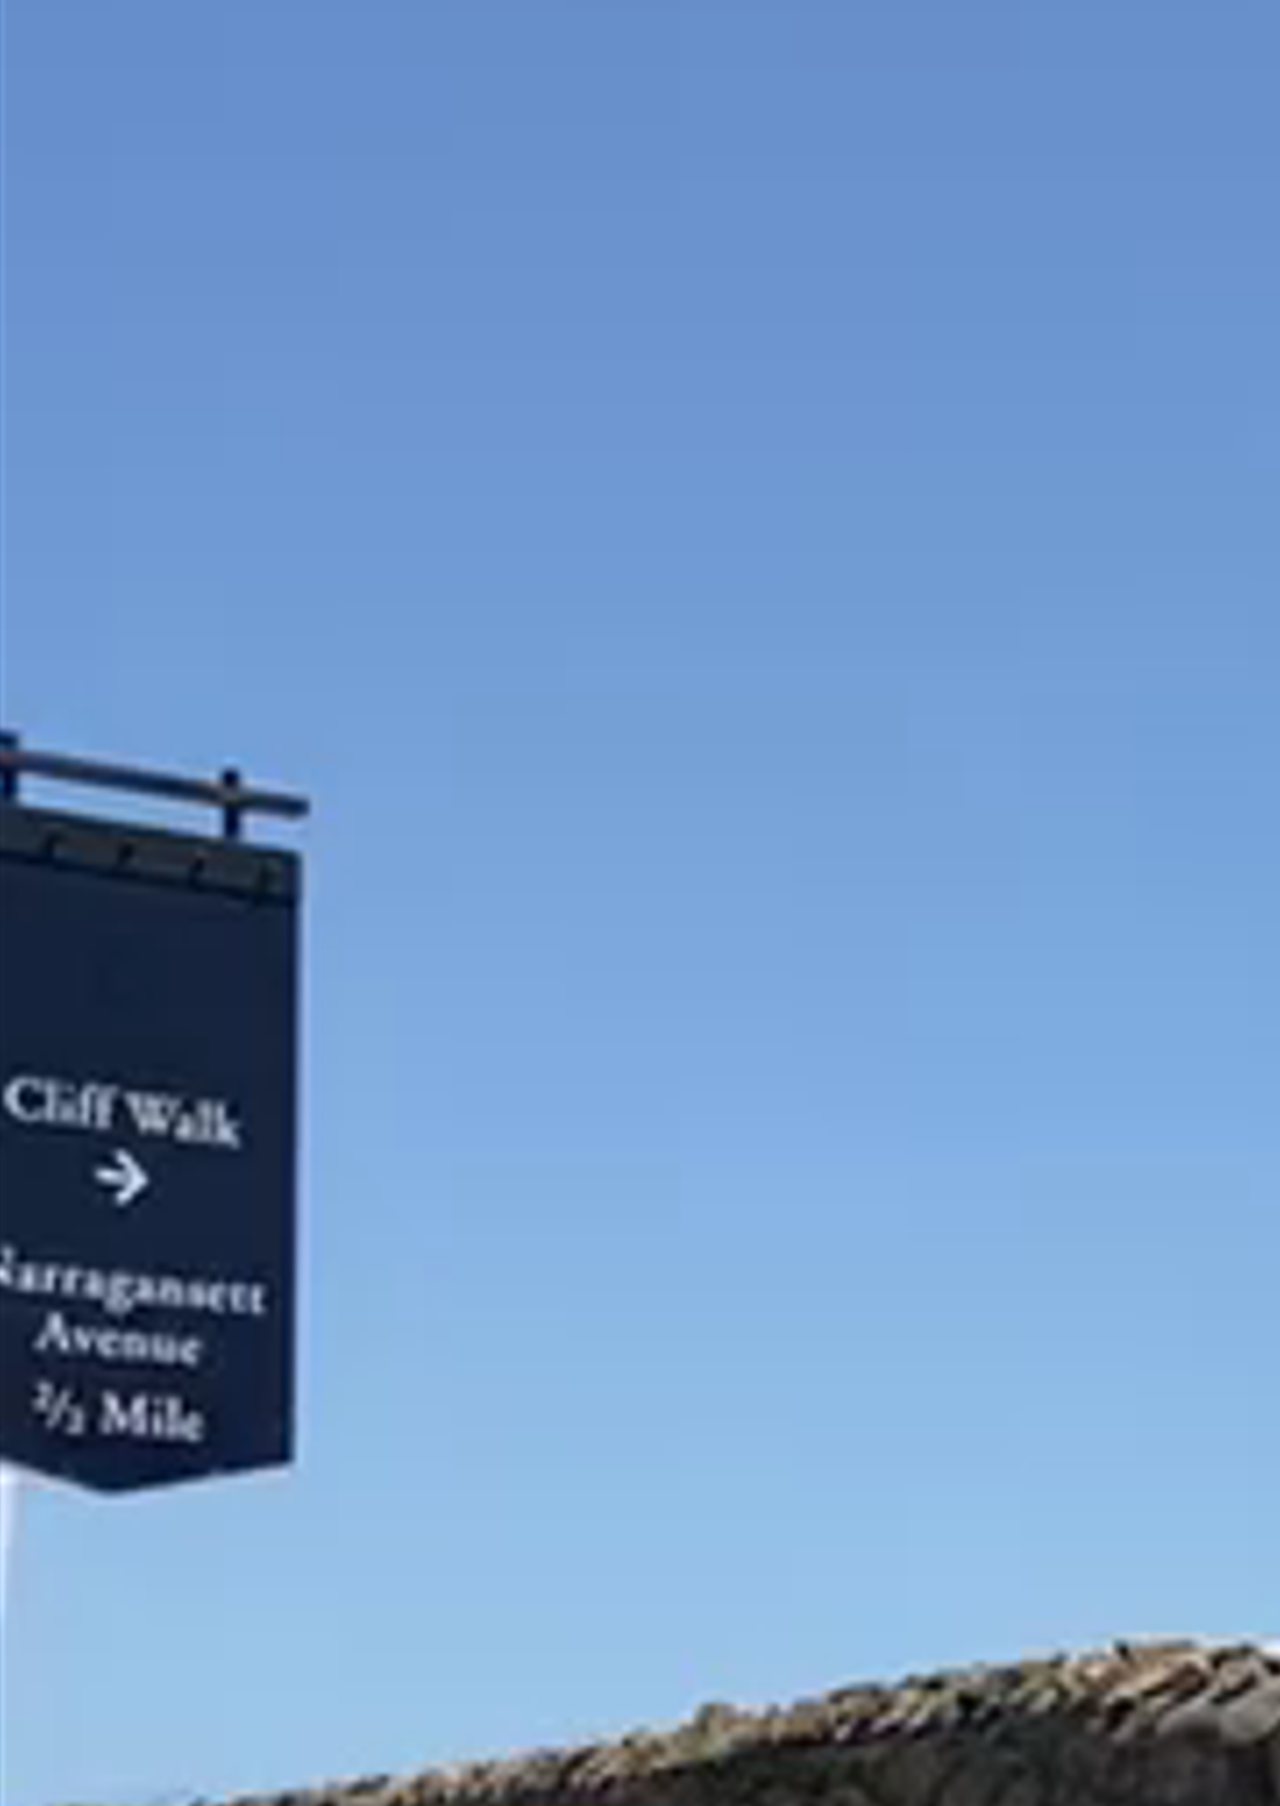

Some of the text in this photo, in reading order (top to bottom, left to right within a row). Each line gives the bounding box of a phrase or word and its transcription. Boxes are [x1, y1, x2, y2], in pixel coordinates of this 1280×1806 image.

[4, 1076, 240, 1150] Cliff Walk
[33, 1312, 202, 1366] Avenue
[99, 1391, 203, 1443] Mile
